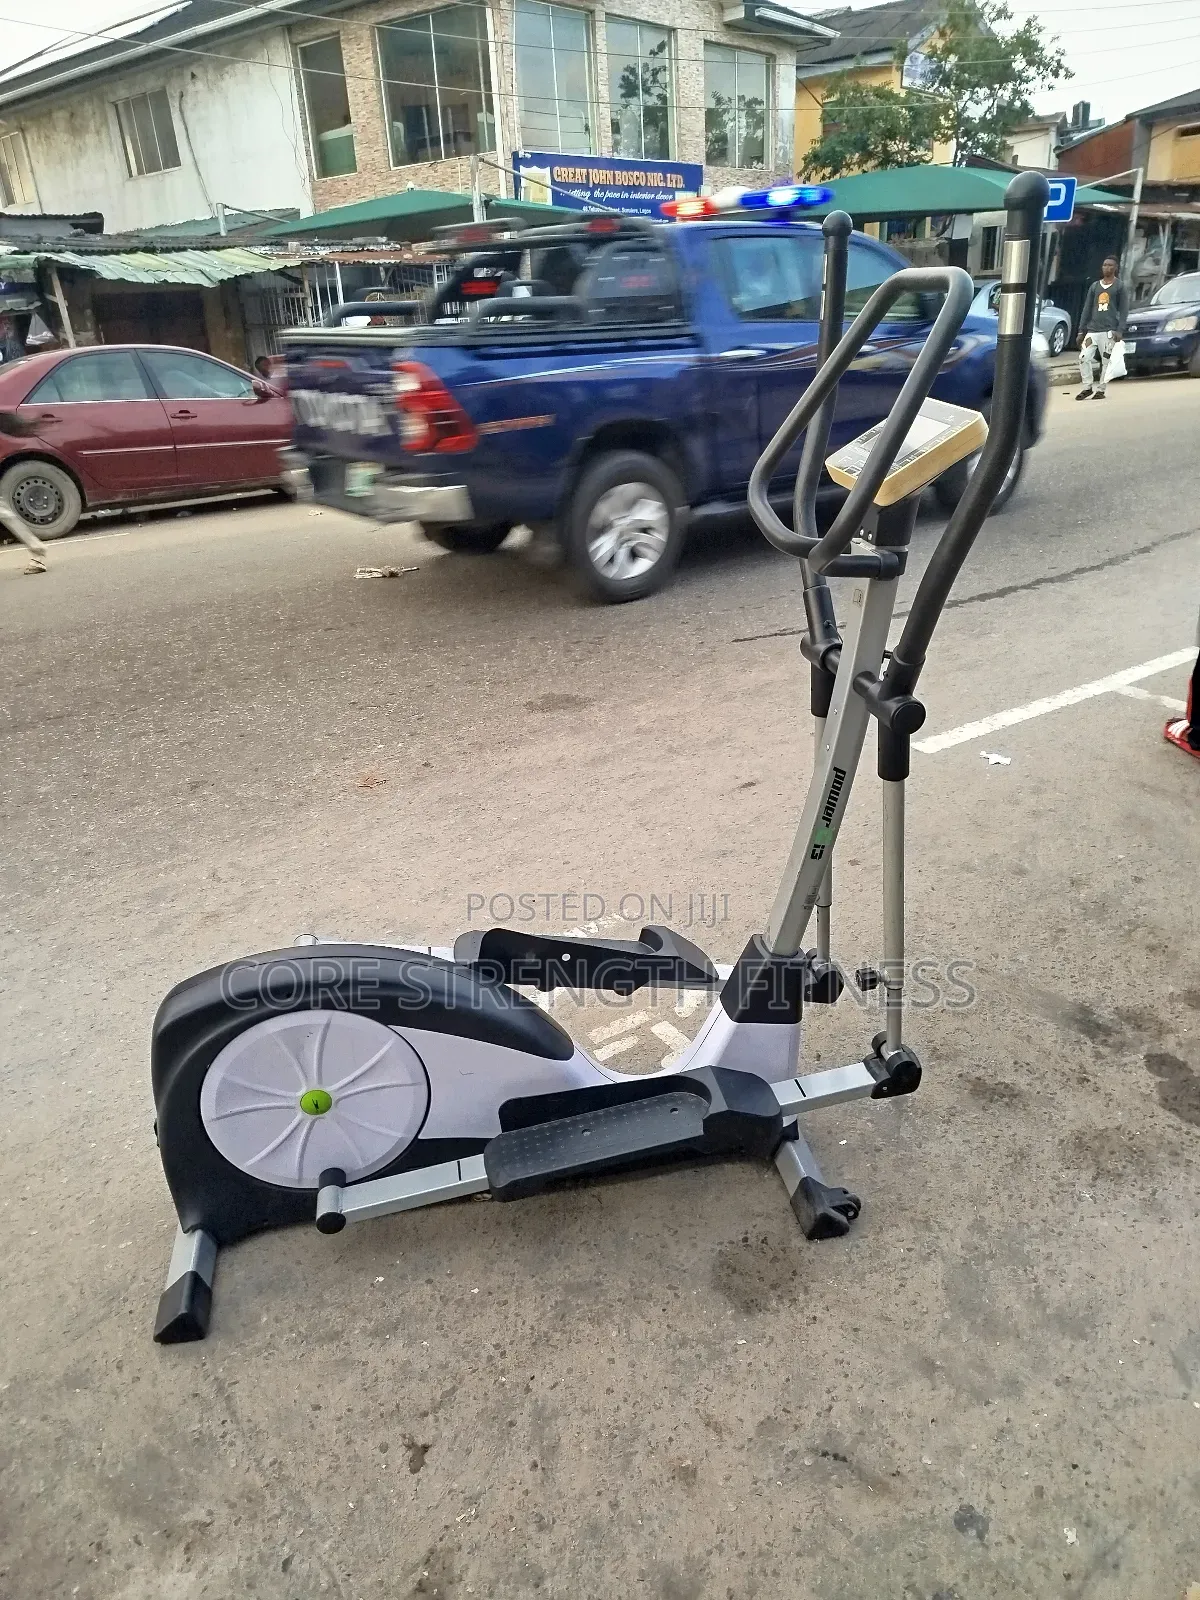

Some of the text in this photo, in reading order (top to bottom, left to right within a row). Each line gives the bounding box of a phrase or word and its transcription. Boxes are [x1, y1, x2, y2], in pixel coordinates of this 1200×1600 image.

[553, 166, 587, 184] GREAT
[588, 168, 614, 188] JOHN
[615, 170, 646, 187] BOSCO
[666, 173, 686, 189] LTD.
[593, 188, 604, 198] the
[603, 190, 620, 202] pace
[621, 190, 629, 199] in
[630, 190, 655, 200] interior
[655, 190, 674, 200] decor
[822, 766, 847, 828] power
